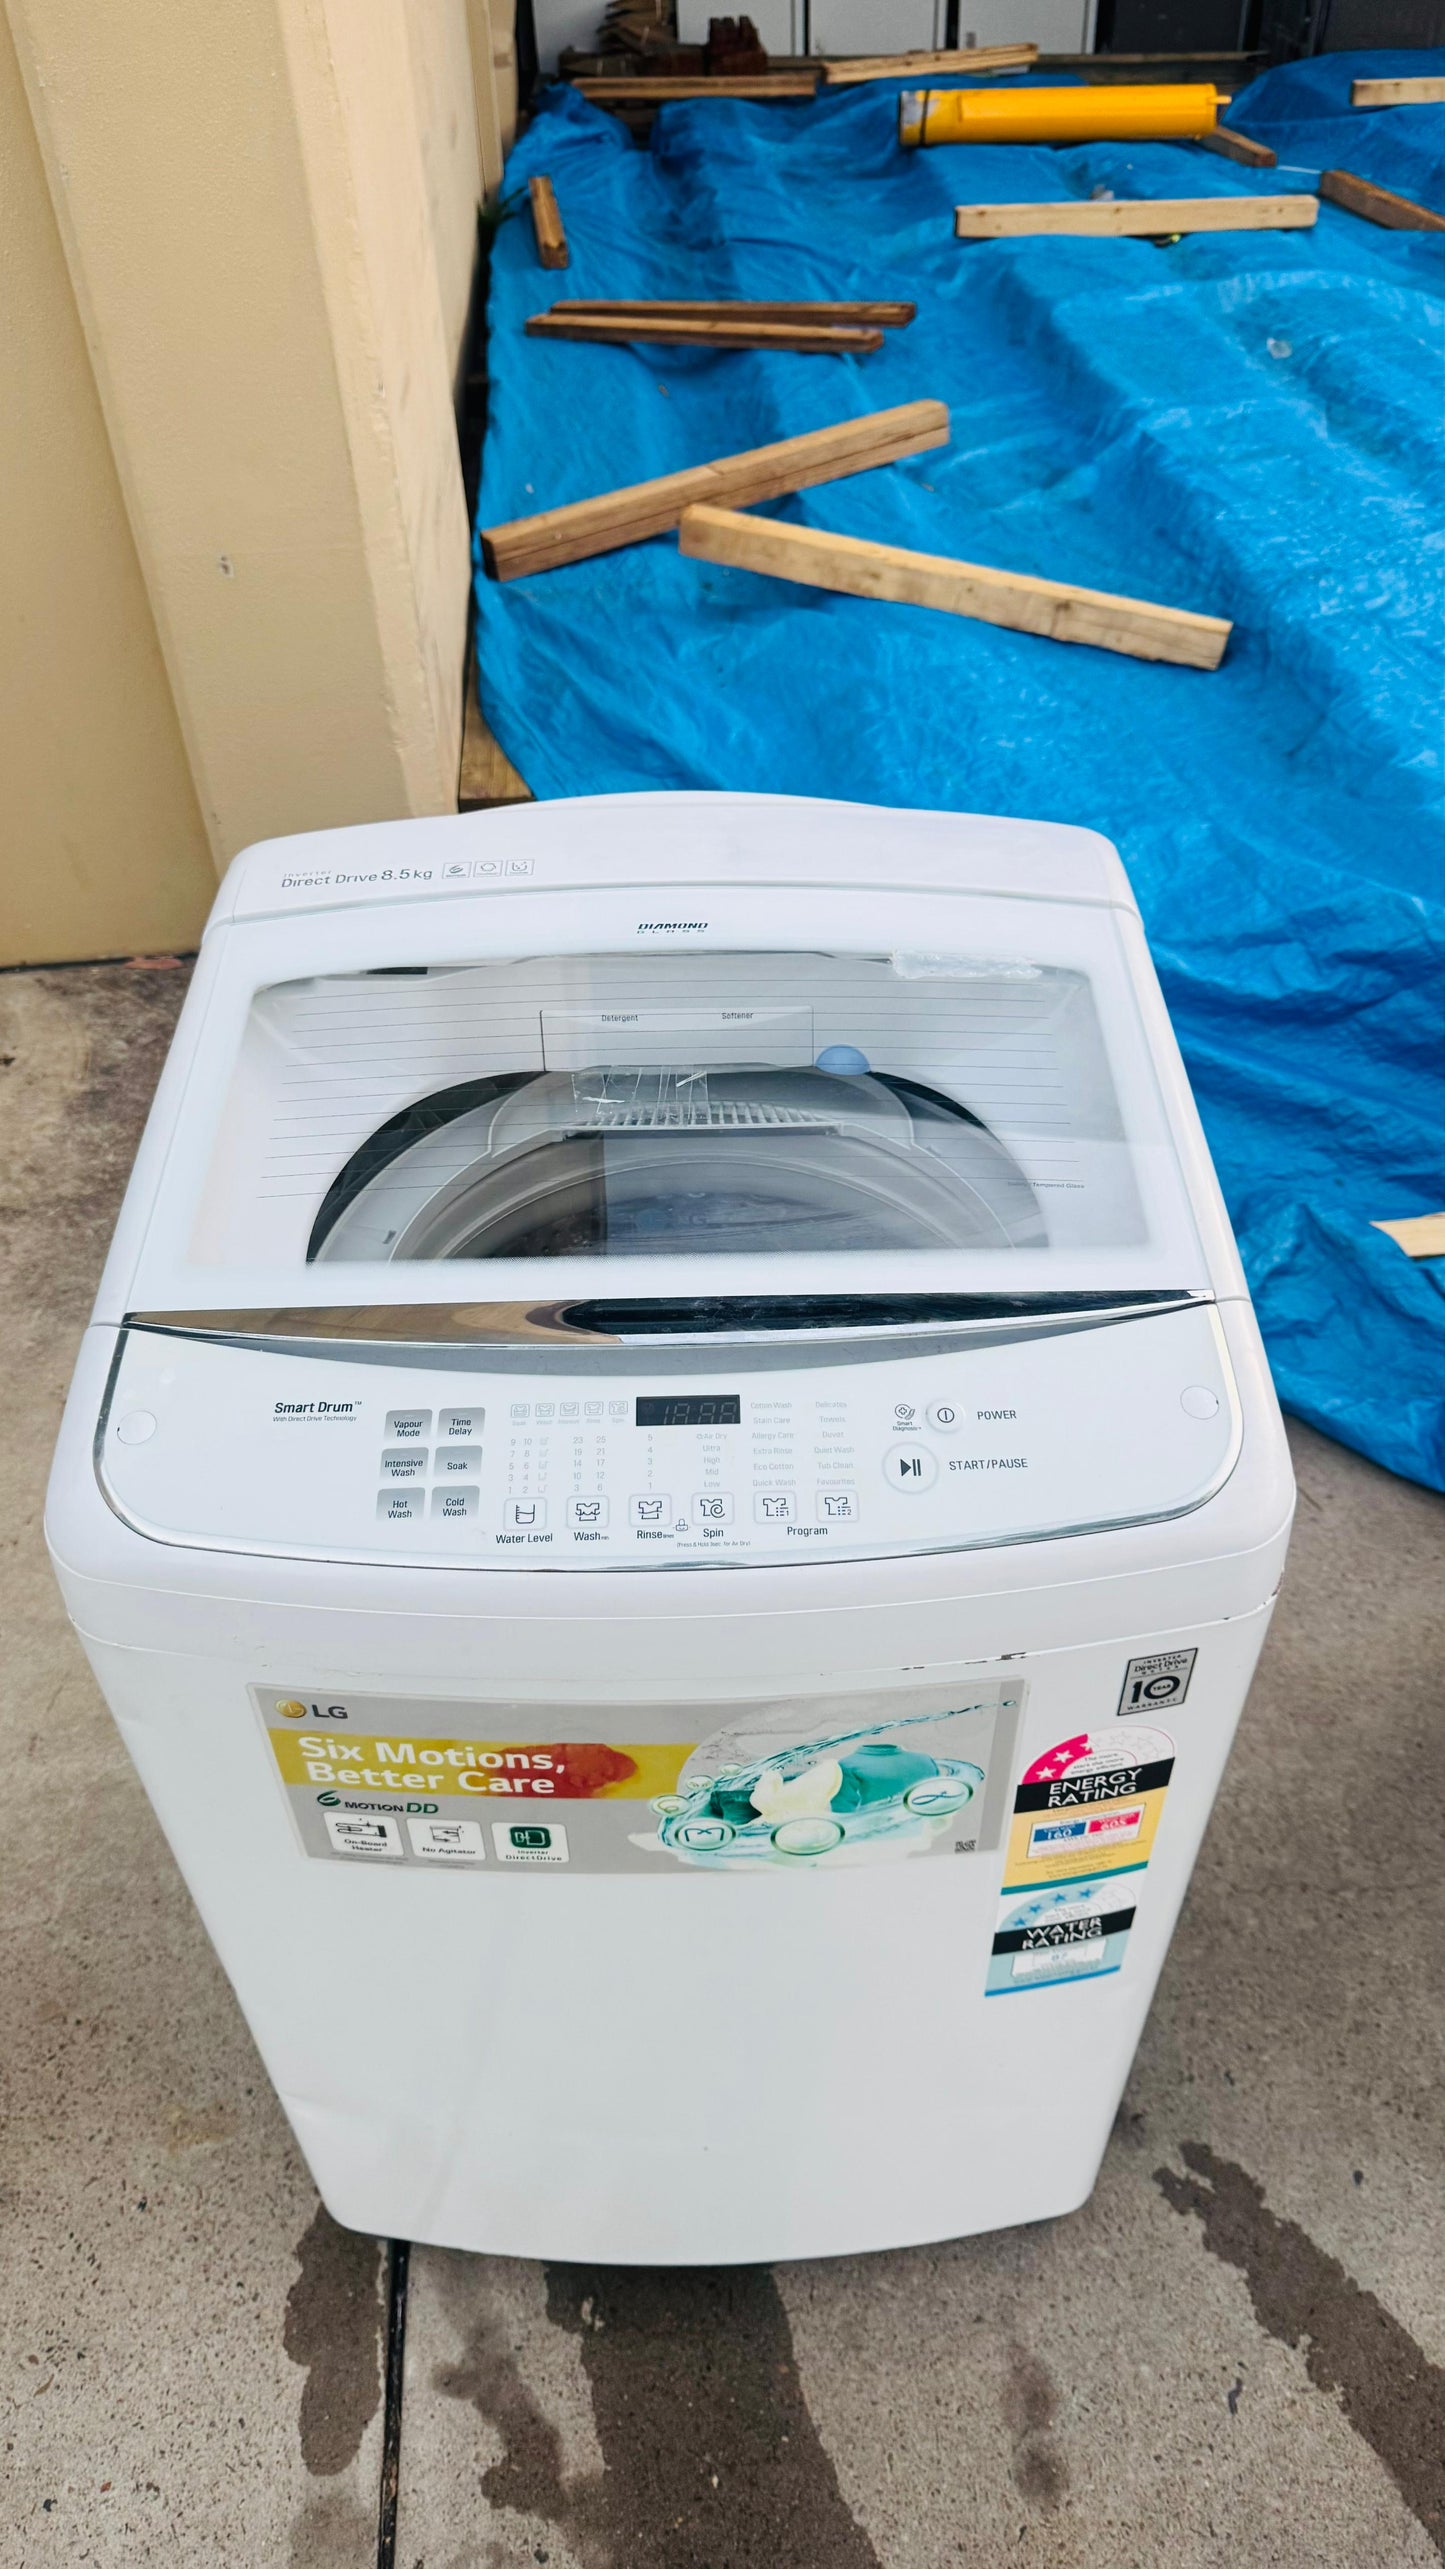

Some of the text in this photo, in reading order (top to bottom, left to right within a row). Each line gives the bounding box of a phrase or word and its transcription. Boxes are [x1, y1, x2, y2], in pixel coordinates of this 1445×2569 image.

[281, 875, 331, 888] Direct
[335, 873, 378, 885] Drive
[638, 922, 708, 930] DIAMOND
[601, 1014, 639, 1023] Detergent
[721, 1012, 754, 1020] Softener
[274, 1402, 314, 1414] Smart
[977, 1410, 1017, 1420] POWER
[394, 1420, 423, 1430] Vapour
[451, 1418, 471, 1426] Time
[396, 1429, 421, 1437] Mode
[448, 1427, 473, 1436] Delay
[573, 1436, 583, 1444] 23
[384, 1459, 424, 1468] Intensive
[703, 1456, 720, 1464] High
[949, 1458, 1028, 1471] START/PAUSE
[447, 1462, 468, 1470] Soak
[769, 1462, 794, 1470] Cotton
[391, 1468, 416, 1477] Wash
[704, 1480, 720, 1488] Low
[752, 1478, 796, 1487] Quick Wash
[392, 1500, 408, 1509] Hot
[445, 1498, 465, 1507] Cold
[387, 1509, 412, 1519] Wash
[442, 1507, 467, 1517] Wash
[573, 1532, 601, 1541] Wash
[636, 1530, 662, 1539] Rinse
[703, 1528, 724, 1539] Spin
[787, 1526, 828, 1537] Program
[495, 1533, 553, 1544] Water Level
[1134, 1658, 1188, 1673] Direct Drive
[1131, 1675, 1181, 1704] 10
[312, 1704, 349, 1720] LG
[298, 1736, 566, 1774] Six Motions,
[305, 1760, 555, 1794] Better Care
[1050, 1768, 1142, 1795] ENERGY
[1048, 1782, 1137, 1807] RATING
[344, 1801, 404, 1812] MOTION
[406, 1802, 439, 1814] DD
[344, 1838, 388, 1847] On-Board
[1026, 1916, 1102, 1938] WATER
[1021, 1928, 1103, 1950] RATING
